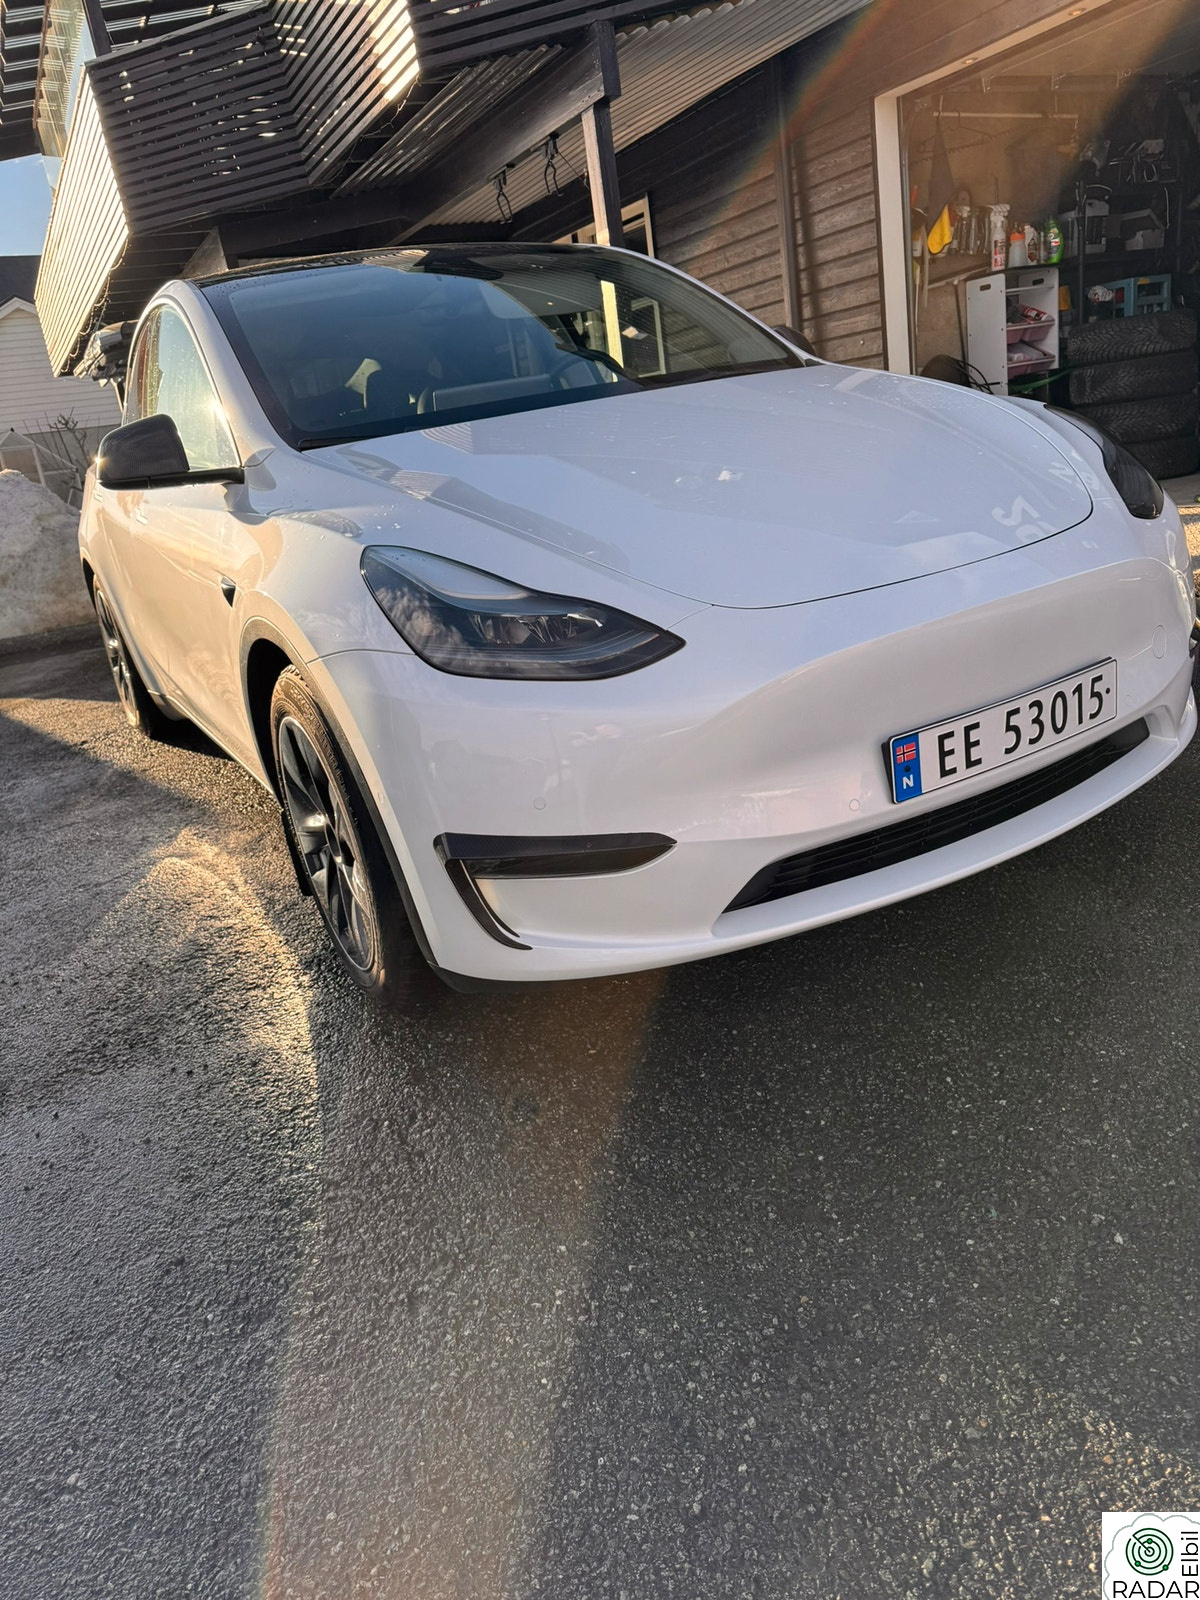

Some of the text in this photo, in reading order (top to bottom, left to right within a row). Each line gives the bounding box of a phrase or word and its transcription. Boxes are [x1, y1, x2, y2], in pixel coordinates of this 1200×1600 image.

[937, 674, 1104, 779] EE 53015
[902, 774, 915, 790] N
